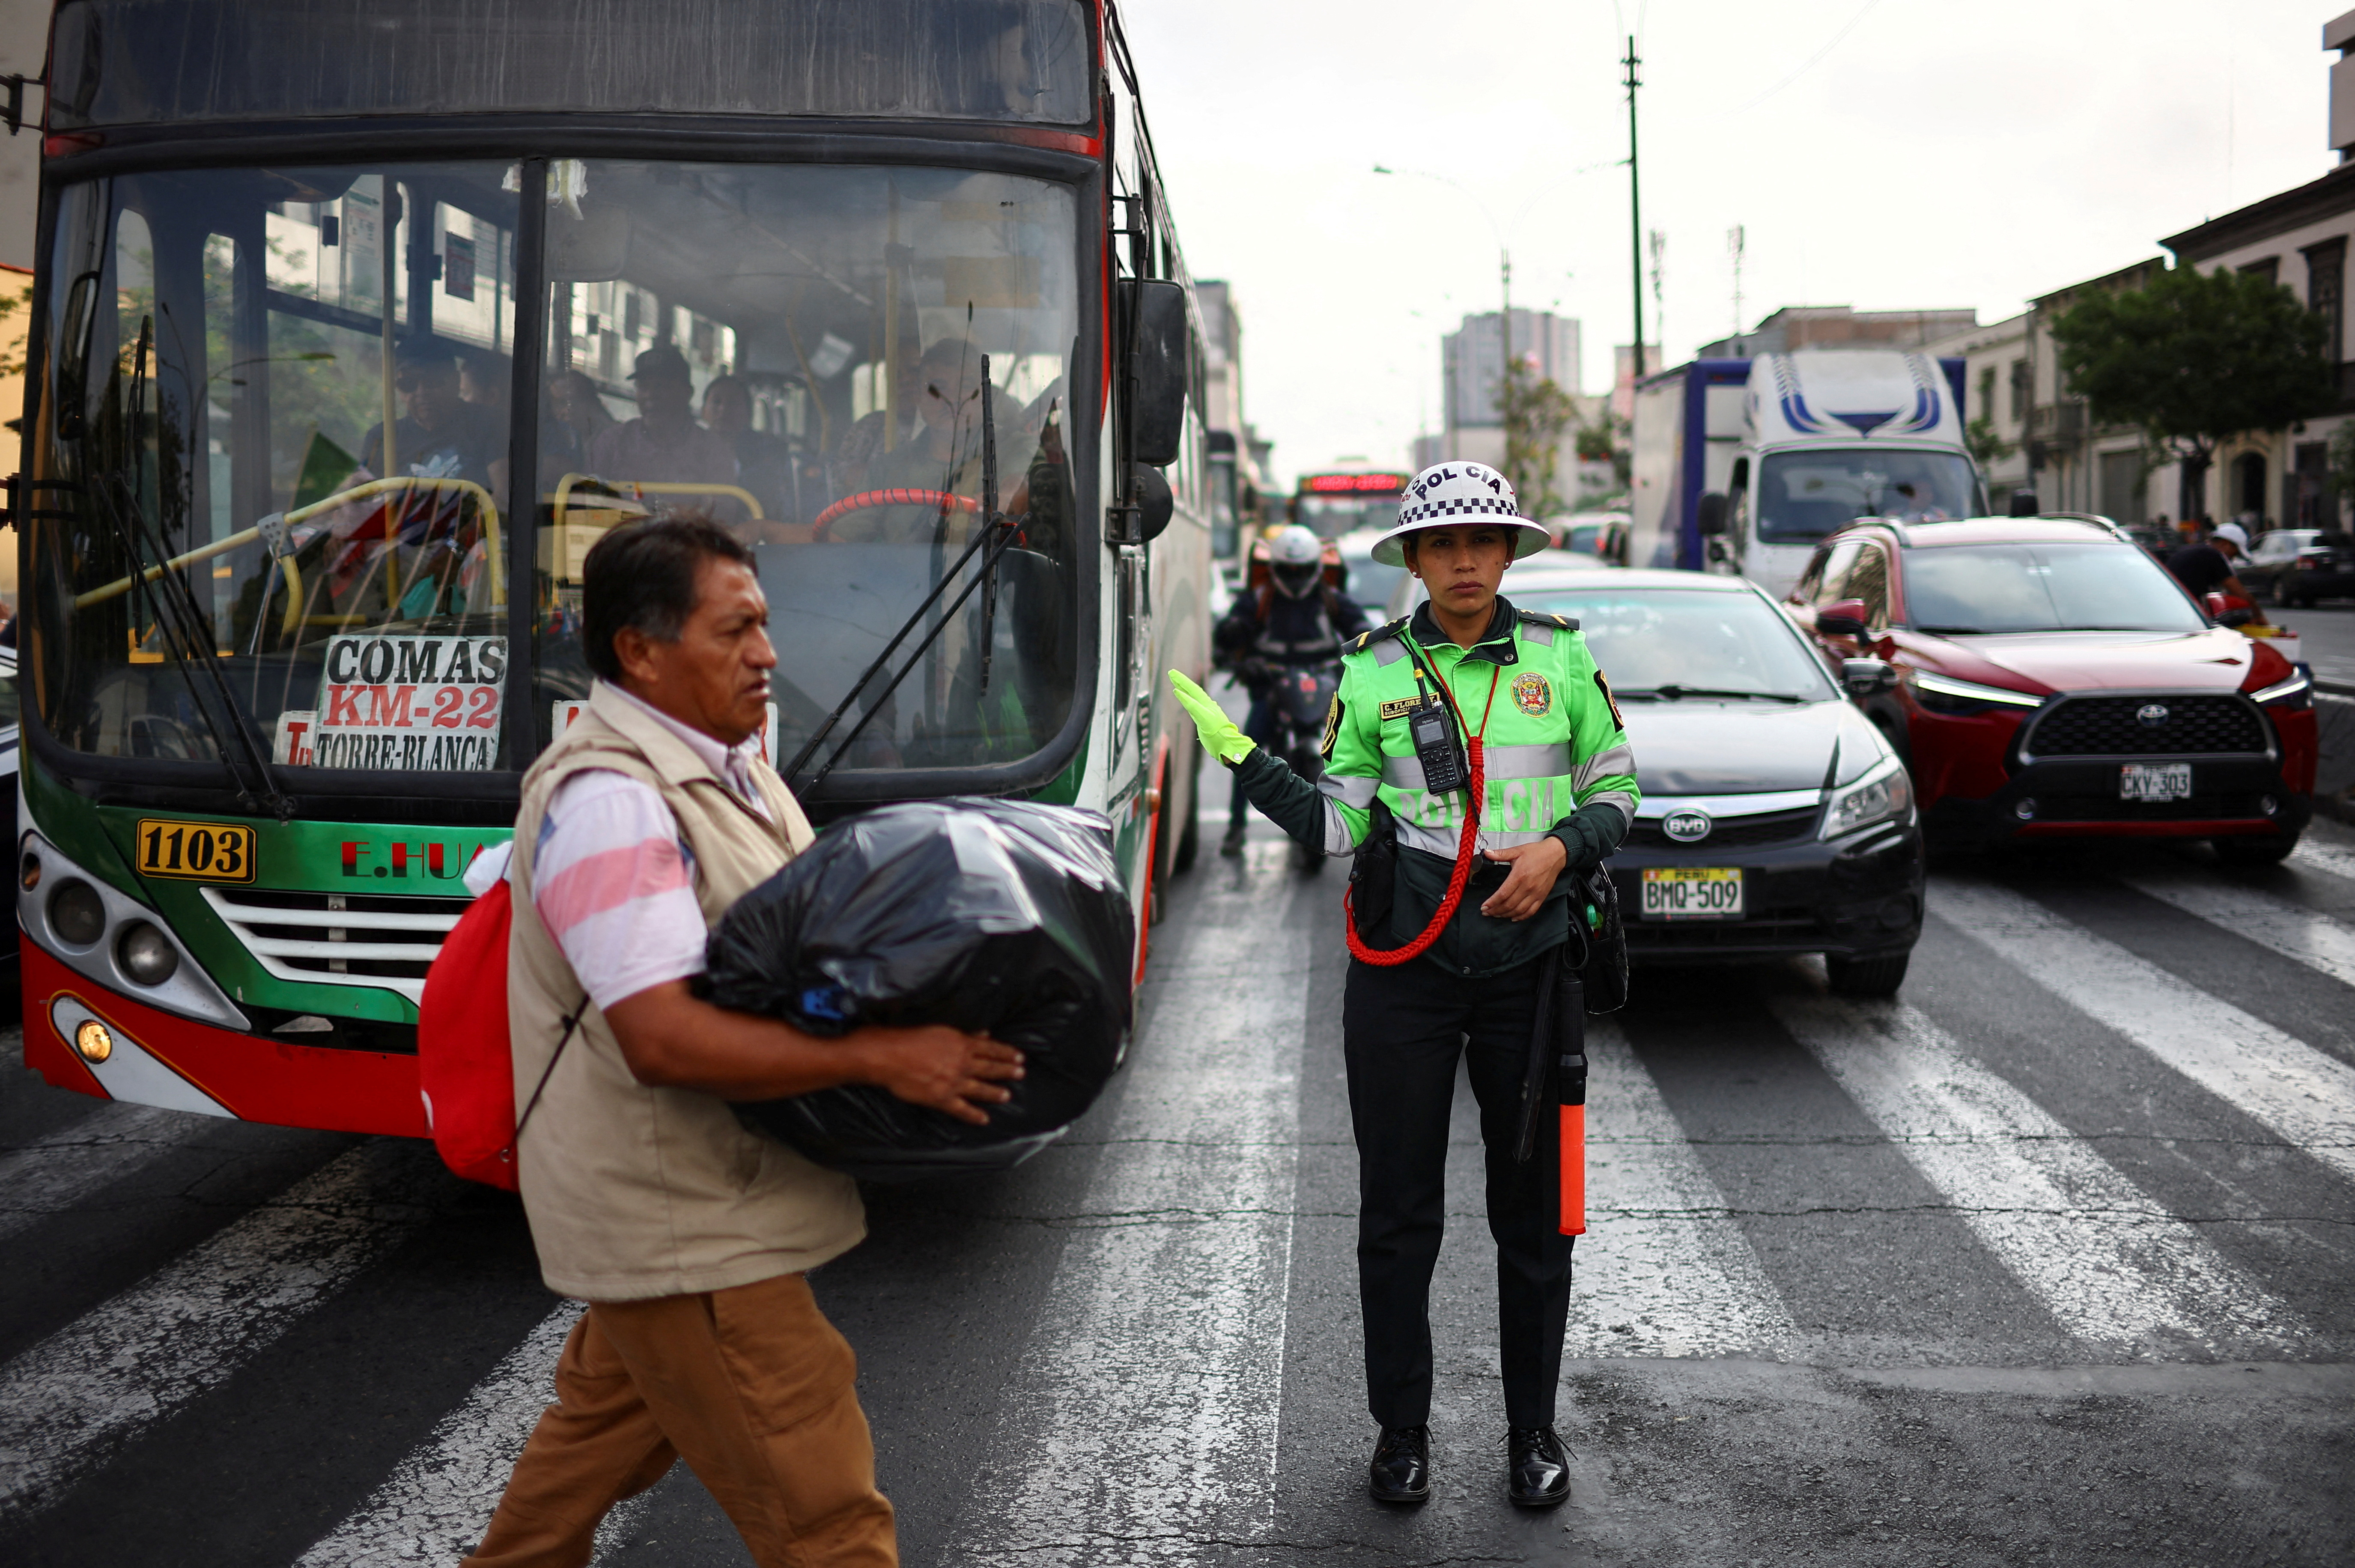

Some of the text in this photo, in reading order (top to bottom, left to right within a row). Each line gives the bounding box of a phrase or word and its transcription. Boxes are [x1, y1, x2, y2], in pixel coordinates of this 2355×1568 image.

[328, 639, 506, 685] COMAS
[323, 685, 498, 729] KM-22
[1394, 699, 1421, 710] FLORE
[317, 733, 487, 771] TORRE-BLANCA
[2123, 773, 2188, 793] CKY-303
[1670, 819, 1705, 832] BYD
[145, 826, 243, 873] 1103
[1647, 881, 1738, 909] BMQ-509
